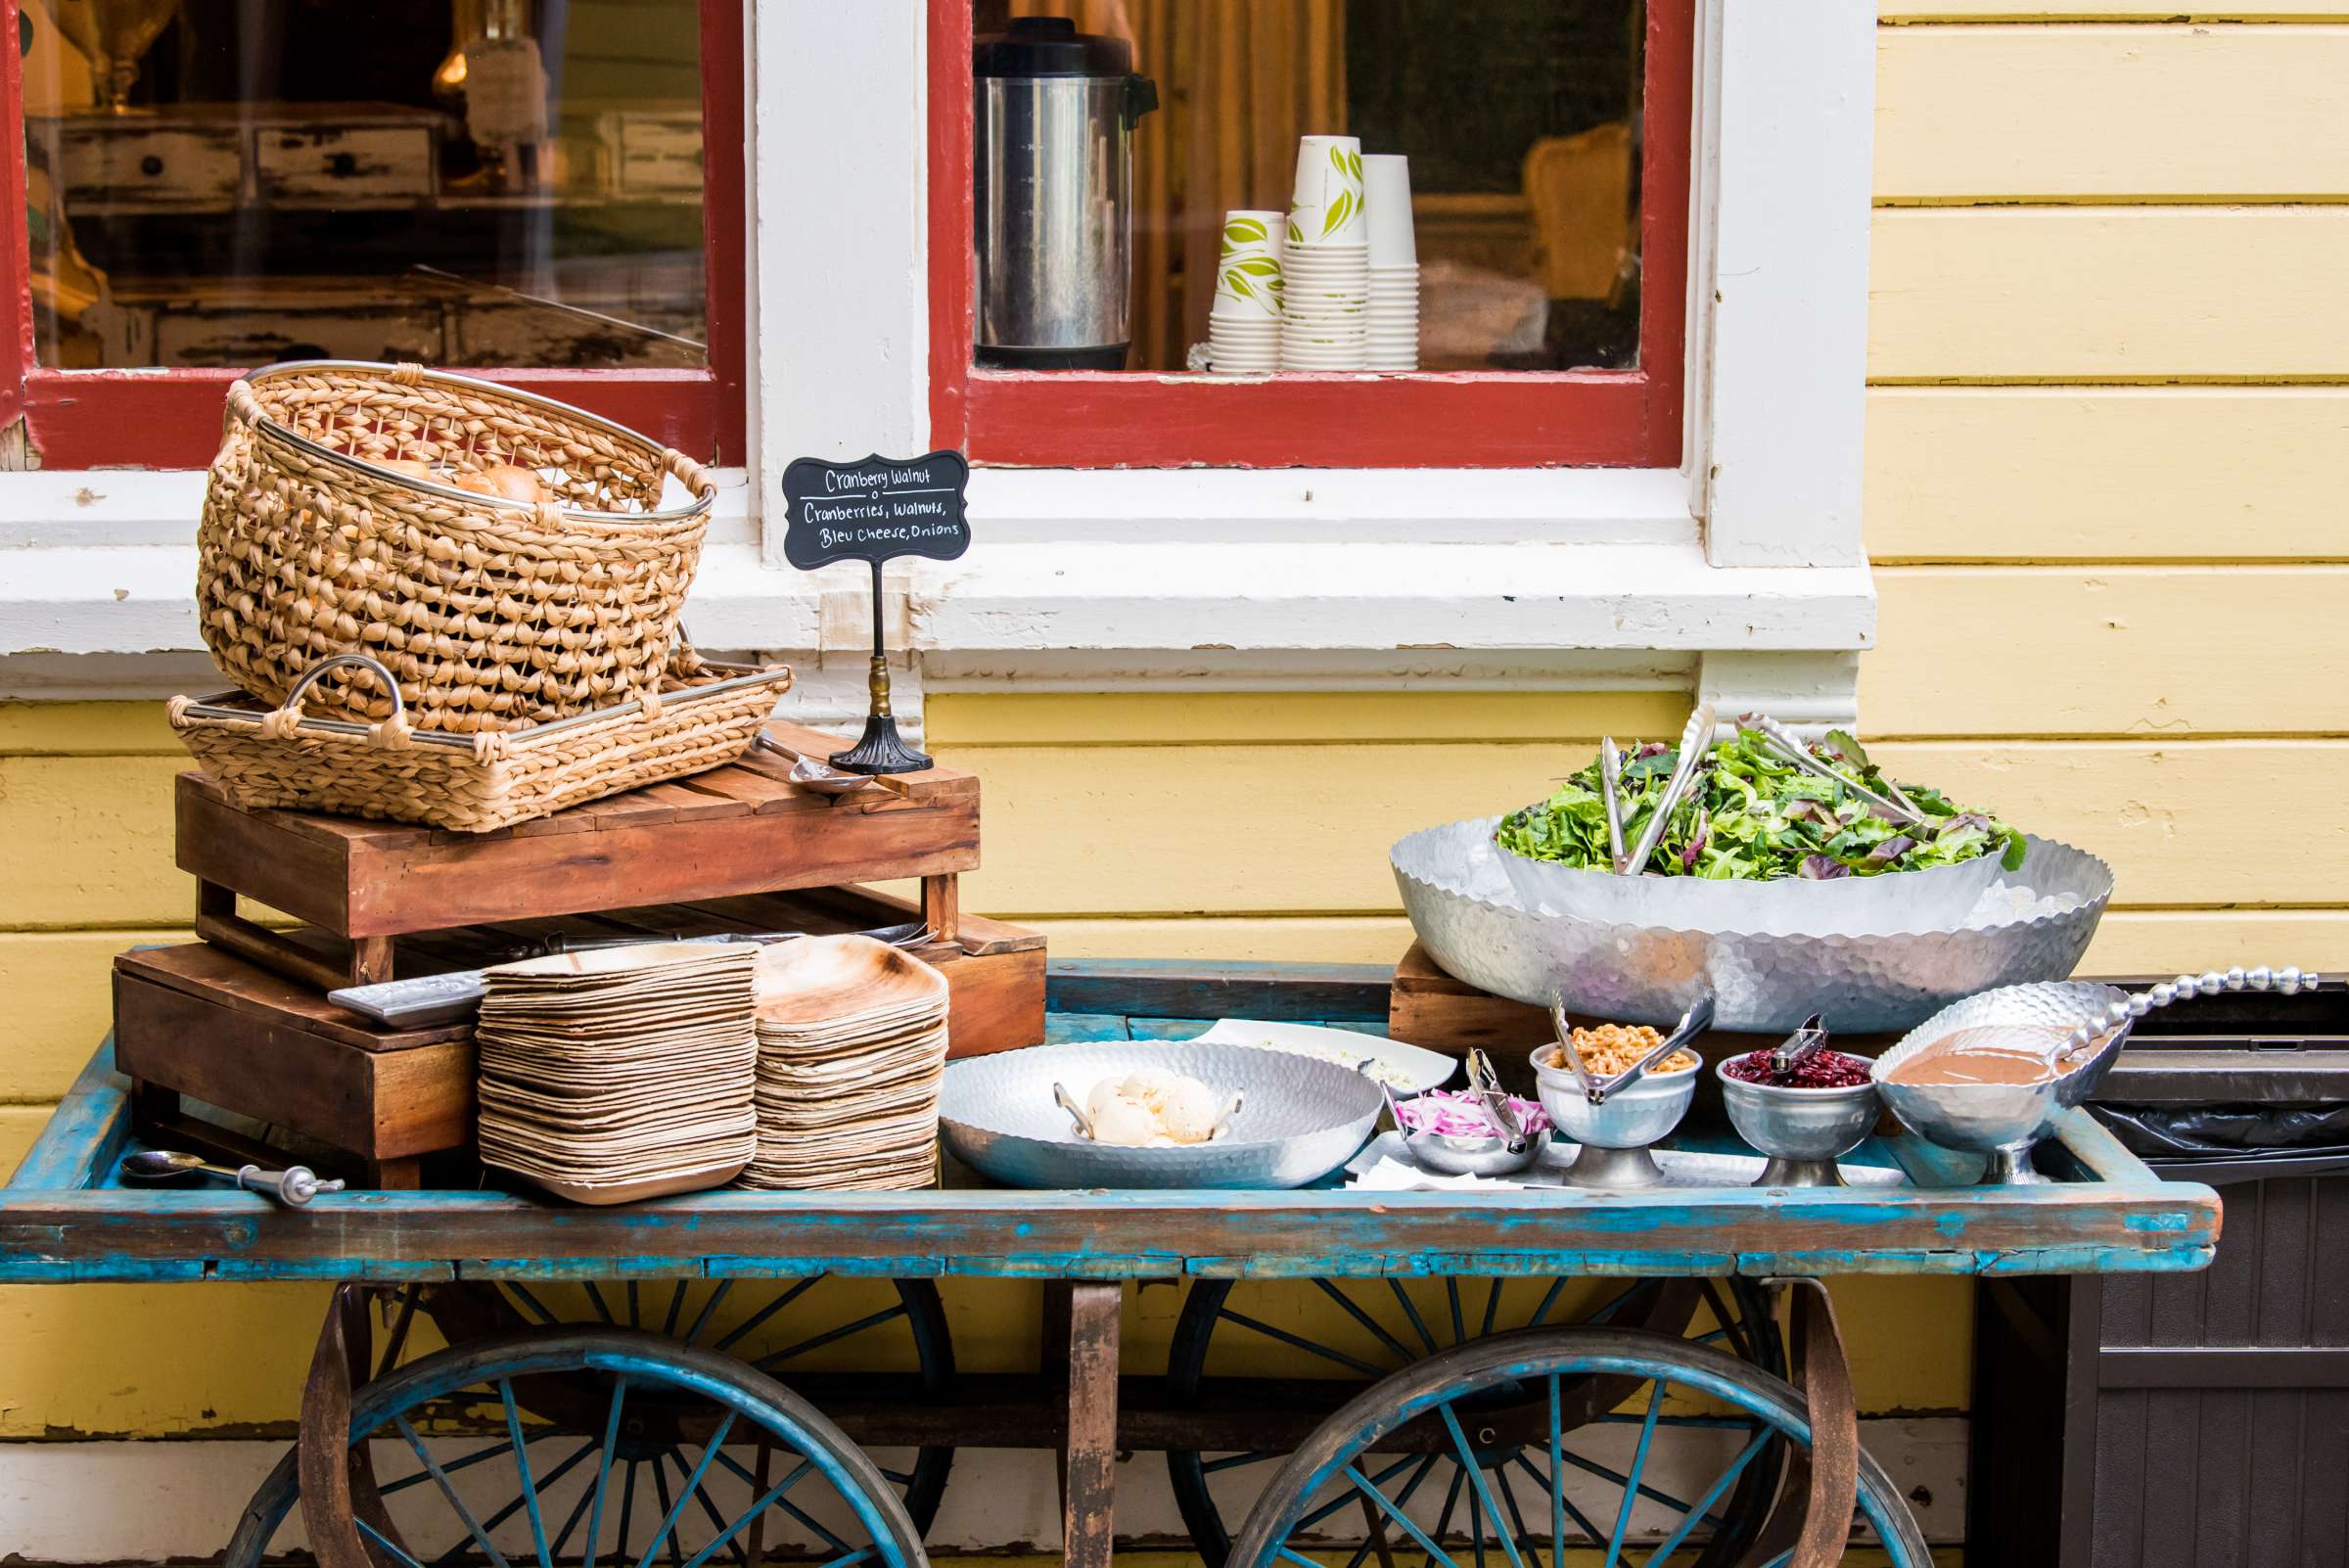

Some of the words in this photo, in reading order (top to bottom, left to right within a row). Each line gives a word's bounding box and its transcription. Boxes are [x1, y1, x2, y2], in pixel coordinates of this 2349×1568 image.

[825, 470, 888, 492] Cranberry
[891, 468, 931, 484] Walnut
[805, 502, 890, 524] Cranberries,
[894, 501, 946, 517] Walnuts,
[819, 528, 852, 548] Bleu
